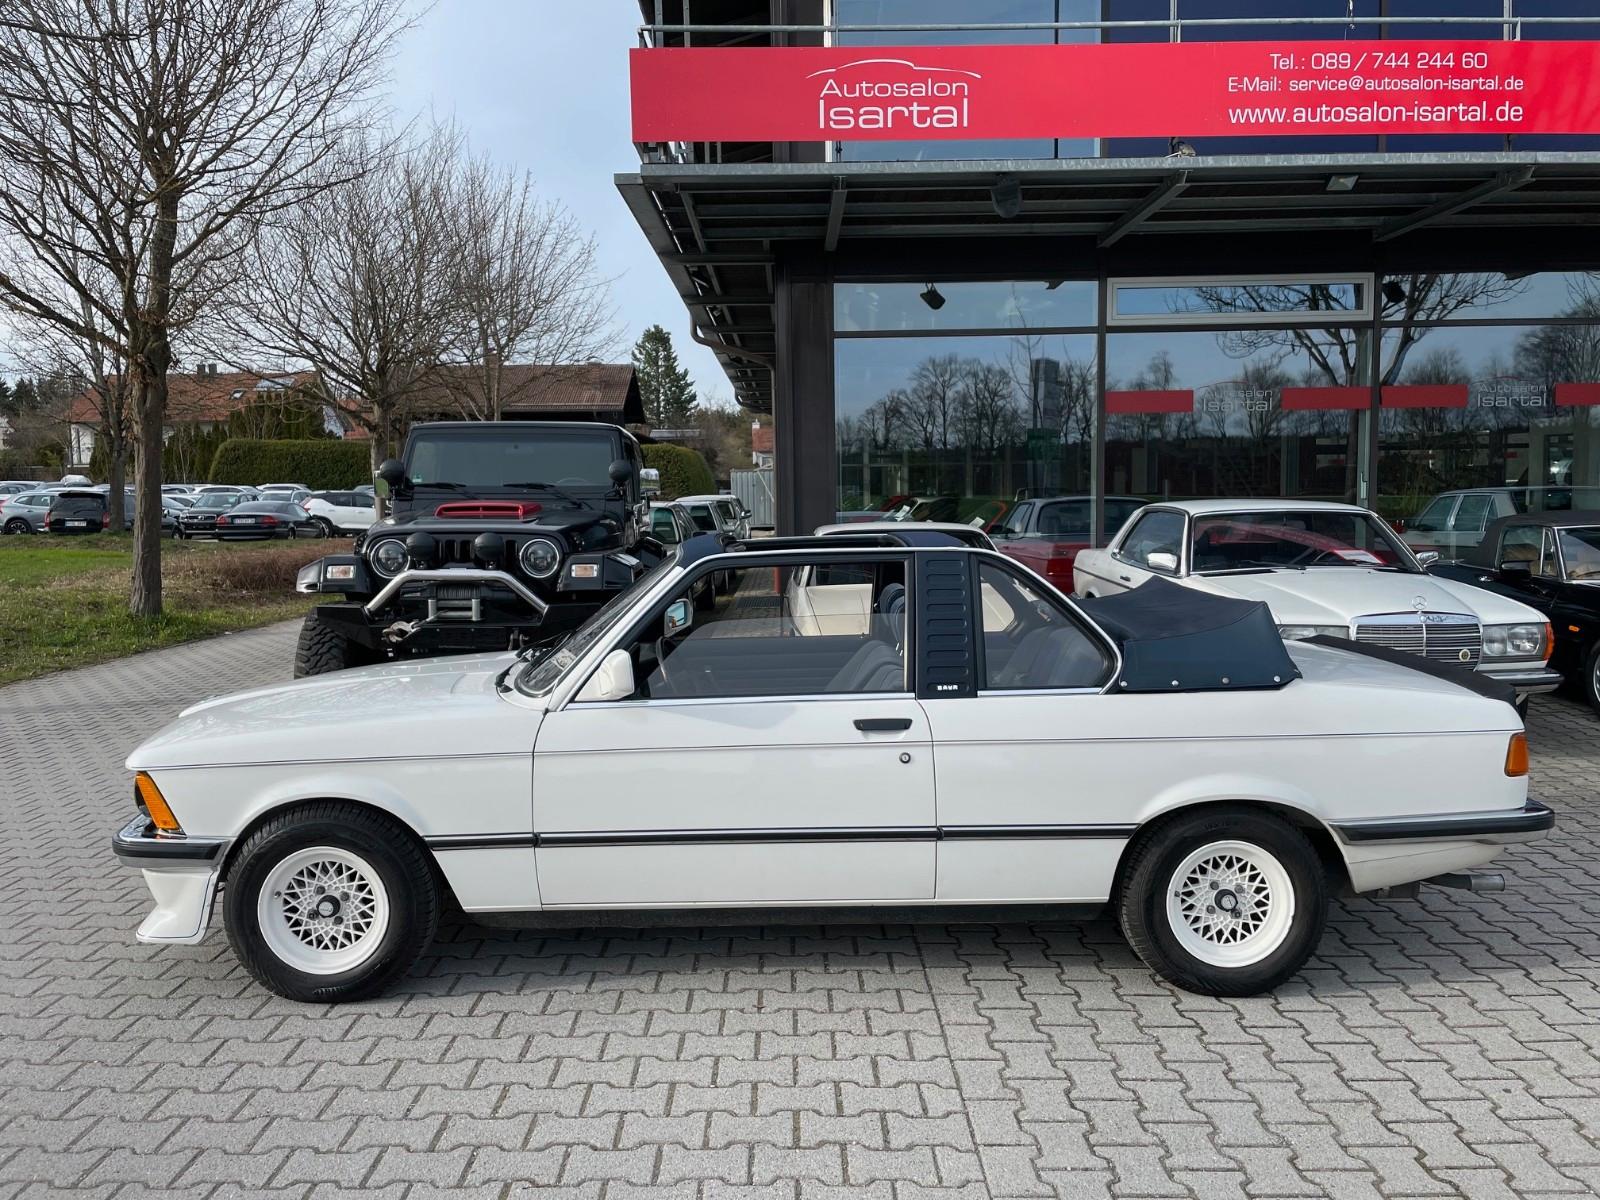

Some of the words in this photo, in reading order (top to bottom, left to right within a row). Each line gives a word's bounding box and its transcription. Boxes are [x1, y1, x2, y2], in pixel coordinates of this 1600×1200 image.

[1417, 52, 1455, 69] 244
[1462, 52, 1488, 69] 60
[819, 78, 968, 98] Autosalon
[1228, 76, 1282, 94] E-Mail:
[1289, 75, 1524, 93] service@autosalon-isartal.de
[819, 97, 968, 129] Isartal
[1228, 100, 1523, 125] www.autosalon-isartal.de
[1203, 396, 1273, 412] Isartal
[1478, 393, 1547, 408] Isartal
